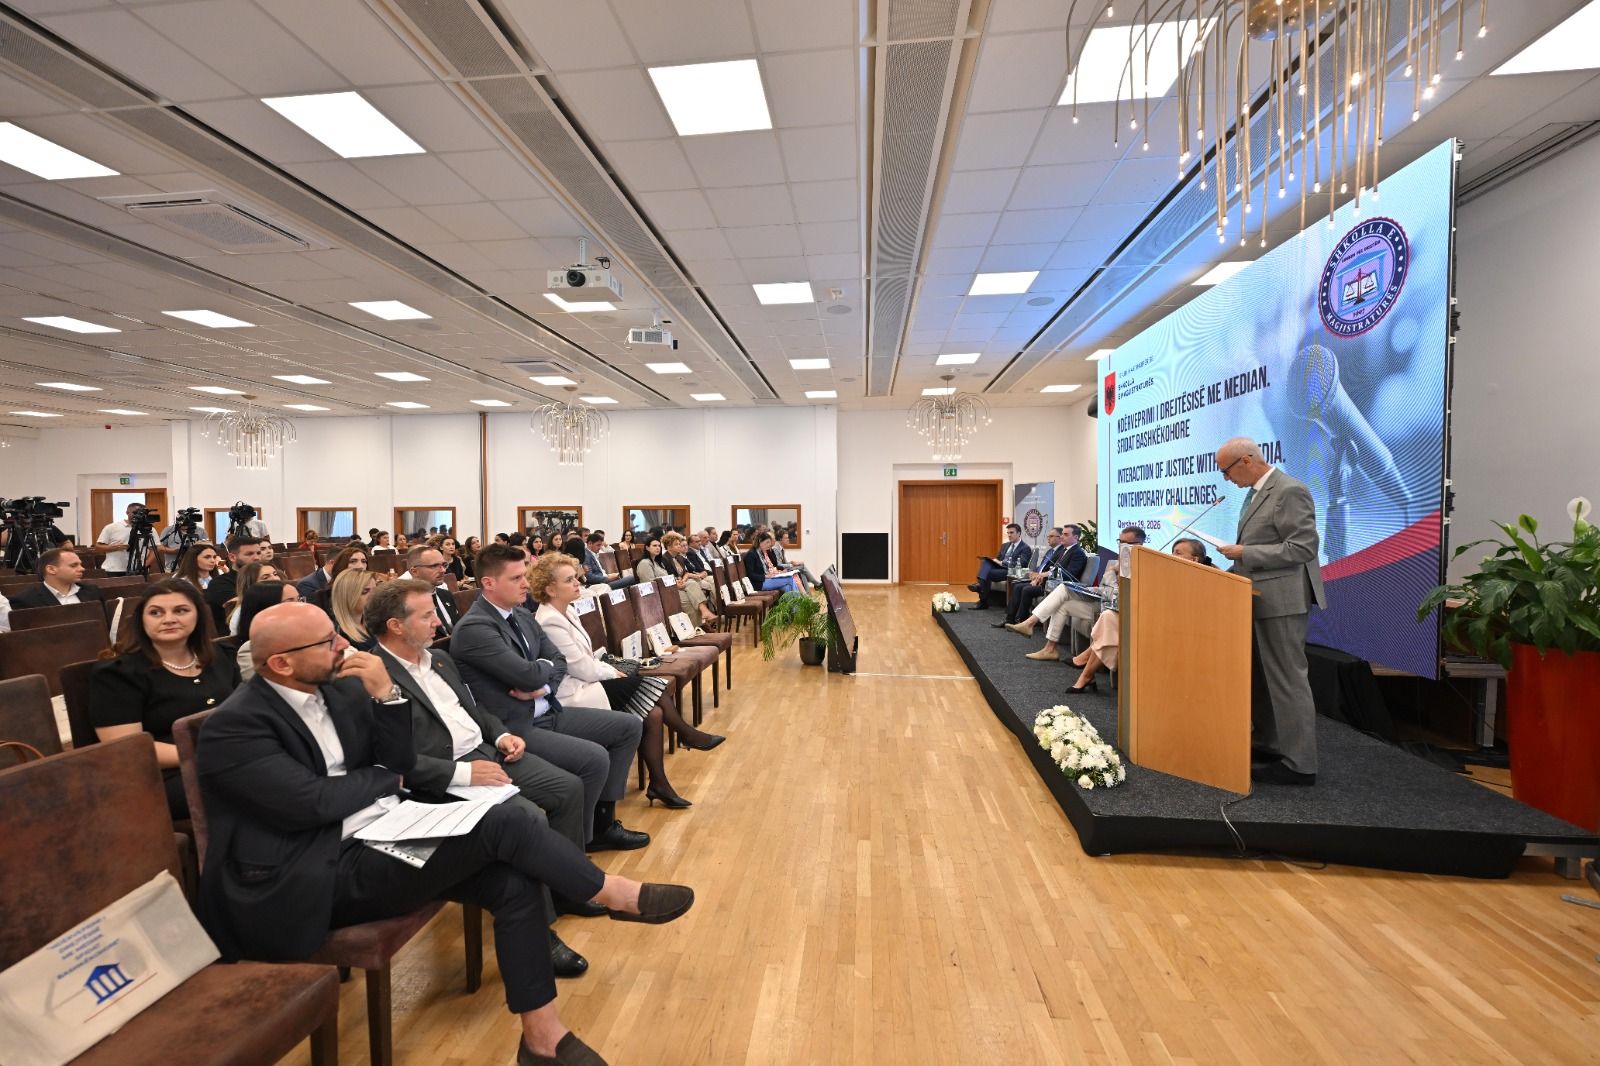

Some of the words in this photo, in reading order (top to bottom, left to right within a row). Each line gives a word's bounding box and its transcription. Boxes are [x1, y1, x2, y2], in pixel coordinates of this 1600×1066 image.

[1330, 224, 1384, 269] SHKOLLA
[1387, 228, 1396, 239] E
[1117, 408, 1154, 434] NDËRVEPRIMI
[1156, 406, 1159, 421] I
[1160, 384, 1205, 420] DREJTËSISË
[1207, 381, 1221, 404] ME
[1224, 365, 1270, 400] MEDIAN.
[1117, 435, 1135, 454] SFIDAT
[1136, 418, 1190, 449] BASHKËKOHORE
[1117, 463, 1154, 484] INTERACTION
[1155, 461, 1163, 479] OF
[1165, 455, 1194, 478] JUSTICE
[1117, 489, 1164, 507] CONTEMPORARY
[1165, 484, 1217, 505] CHALLENGES
[1147, 520, 1161, 530] 2026
